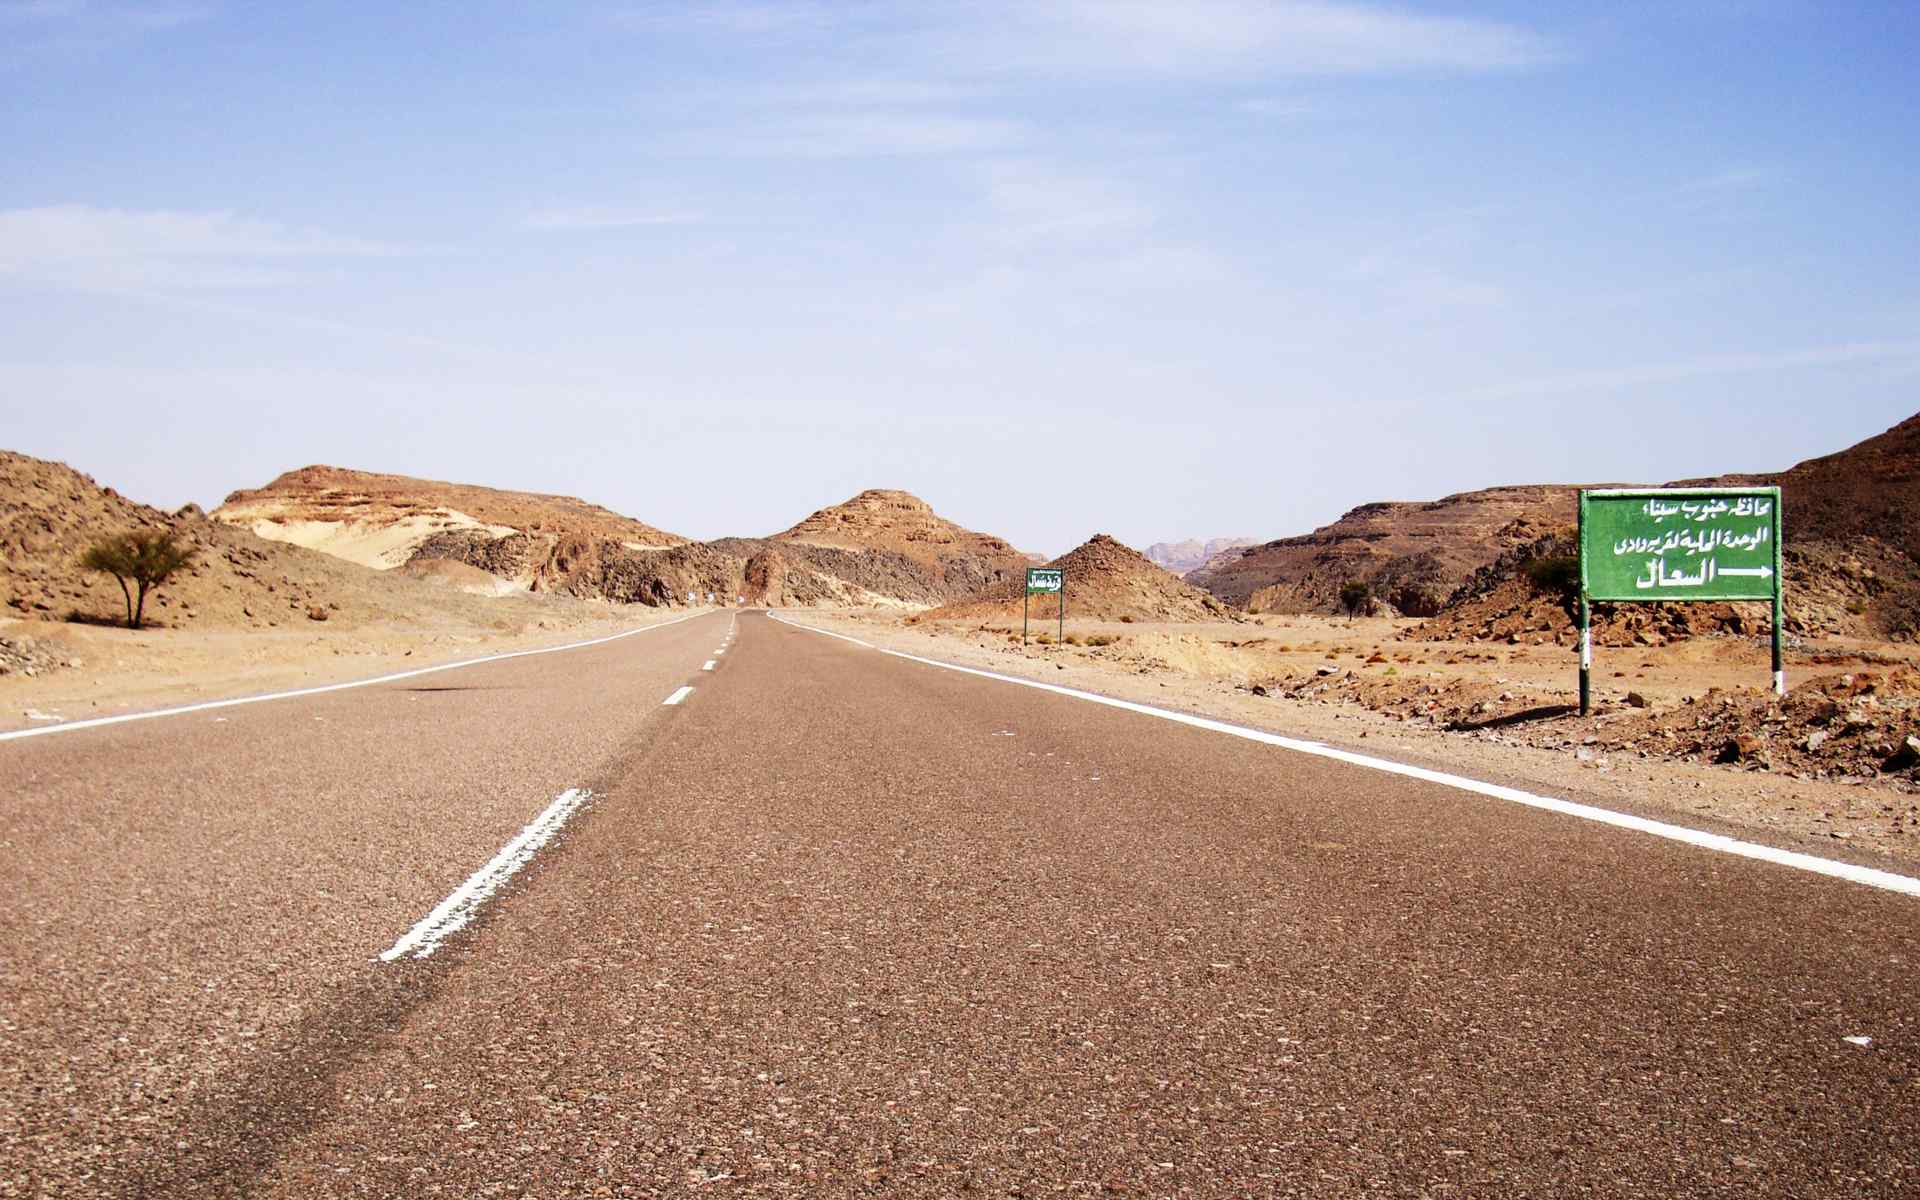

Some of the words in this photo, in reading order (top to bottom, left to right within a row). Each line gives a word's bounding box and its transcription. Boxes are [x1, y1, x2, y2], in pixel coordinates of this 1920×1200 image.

[1643, 499, 1679, 523] سيناء
[1681, 499, 1728, 522] جنوب
[1722, 526, 1768, 551] الوحدة
[1636, 557, 1715, 589] السعال
